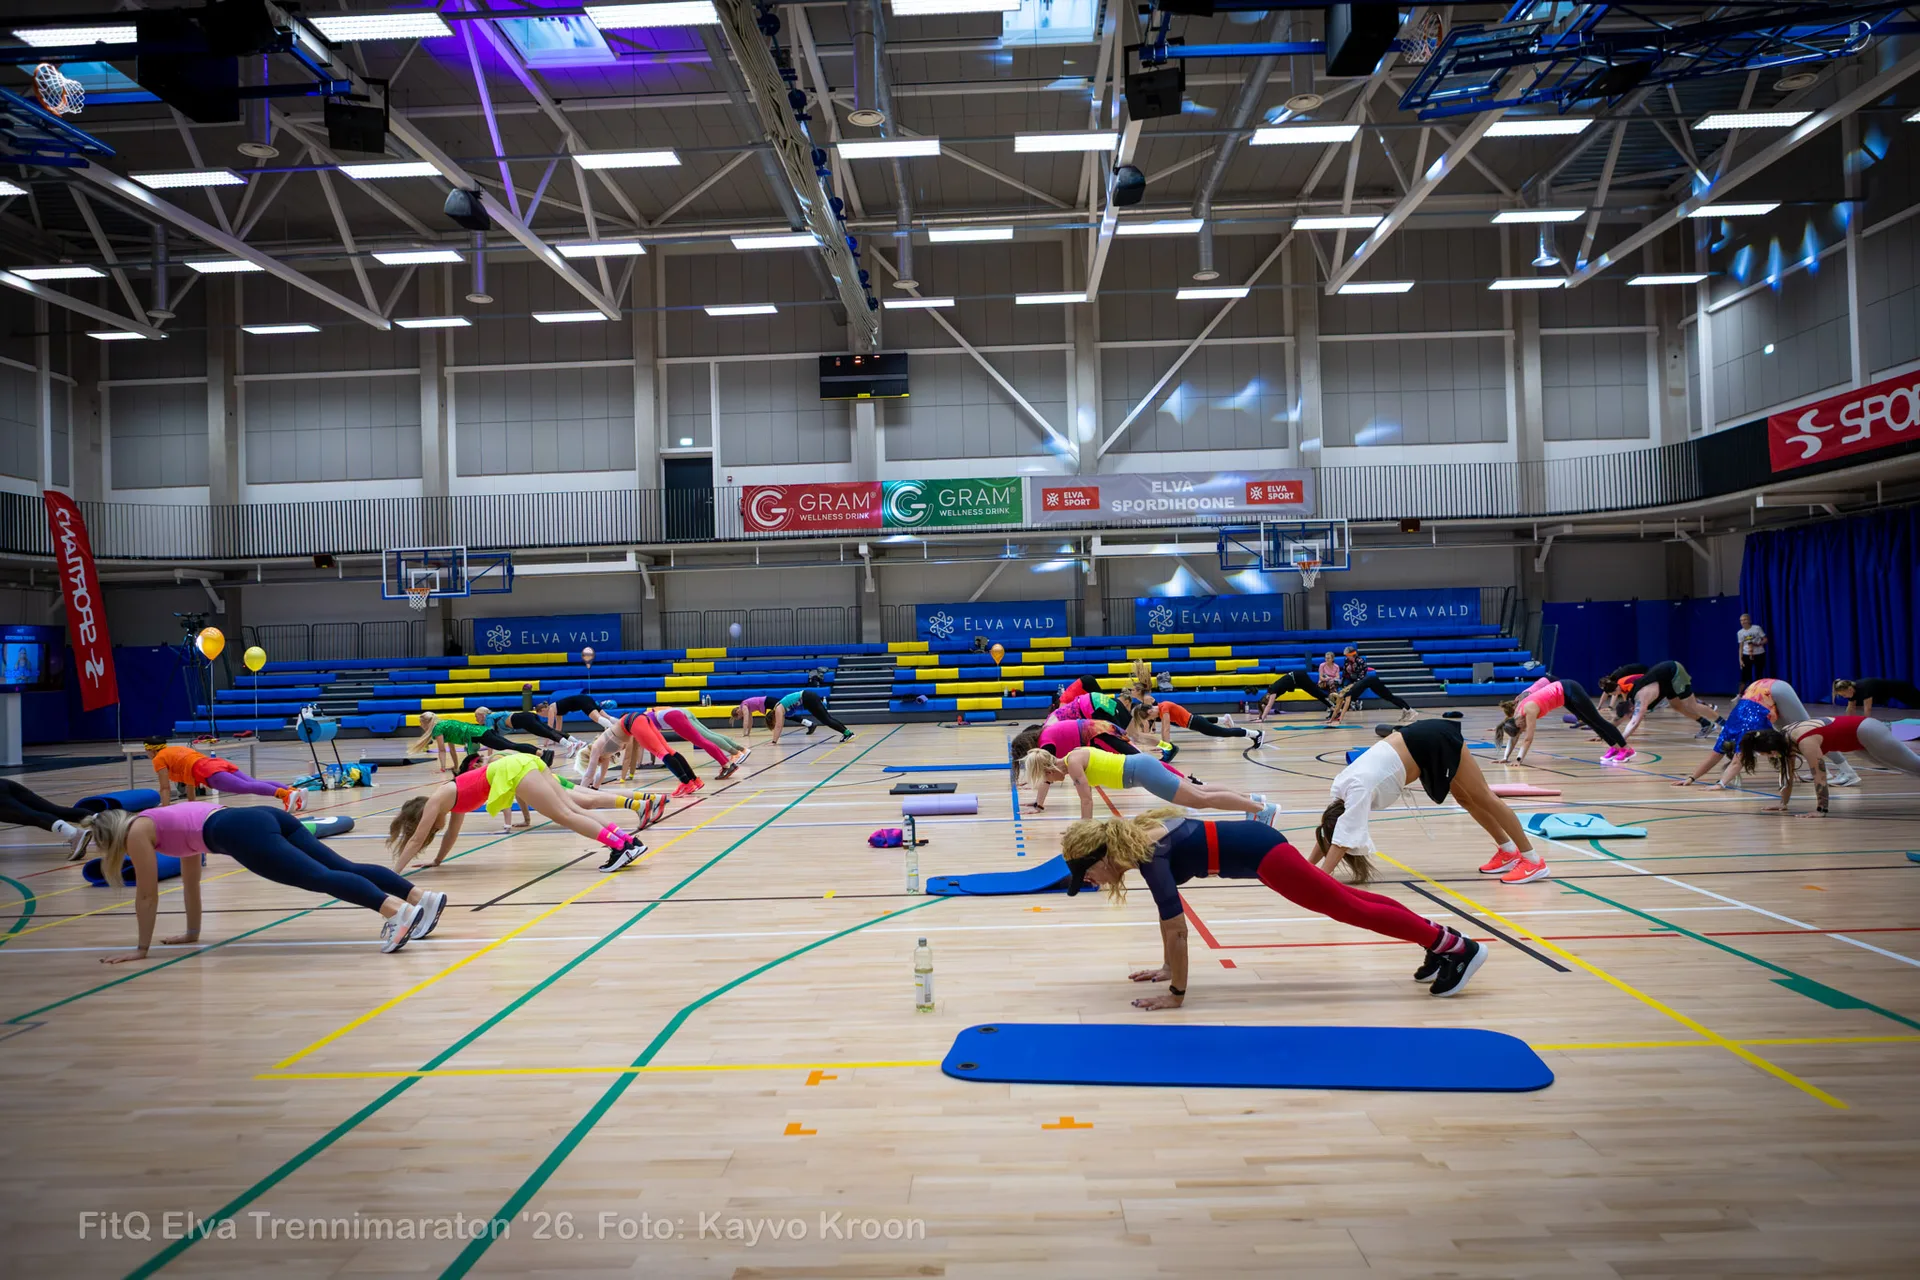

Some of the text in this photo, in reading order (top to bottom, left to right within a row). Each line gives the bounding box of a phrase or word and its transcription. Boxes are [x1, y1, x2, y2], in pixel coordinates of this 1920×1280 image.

[1151, 480, 1194, 494] ELVA
[1267, 485, 1287, 493] ELVA
[1063, 491, 1084, 499] ELVA
[1267, 491, 1295, 500] SPORT
[1064, 497, 1091, 506] SPORT
[1111, 496, 1235, 513] SPORDIHOONE
[800, 512, 870, 521] WELLNESS DRINK
[939, 507, 1010, 517] WELLNESS DRINK
[1181, 610, 1272, 624] ELVA VALD
[1377, 604, 1469, 618] ELVA VALD
[964, 616, 1054, 631] ELVA VALD
[521, 630, 609, 645] ELVA VALD
